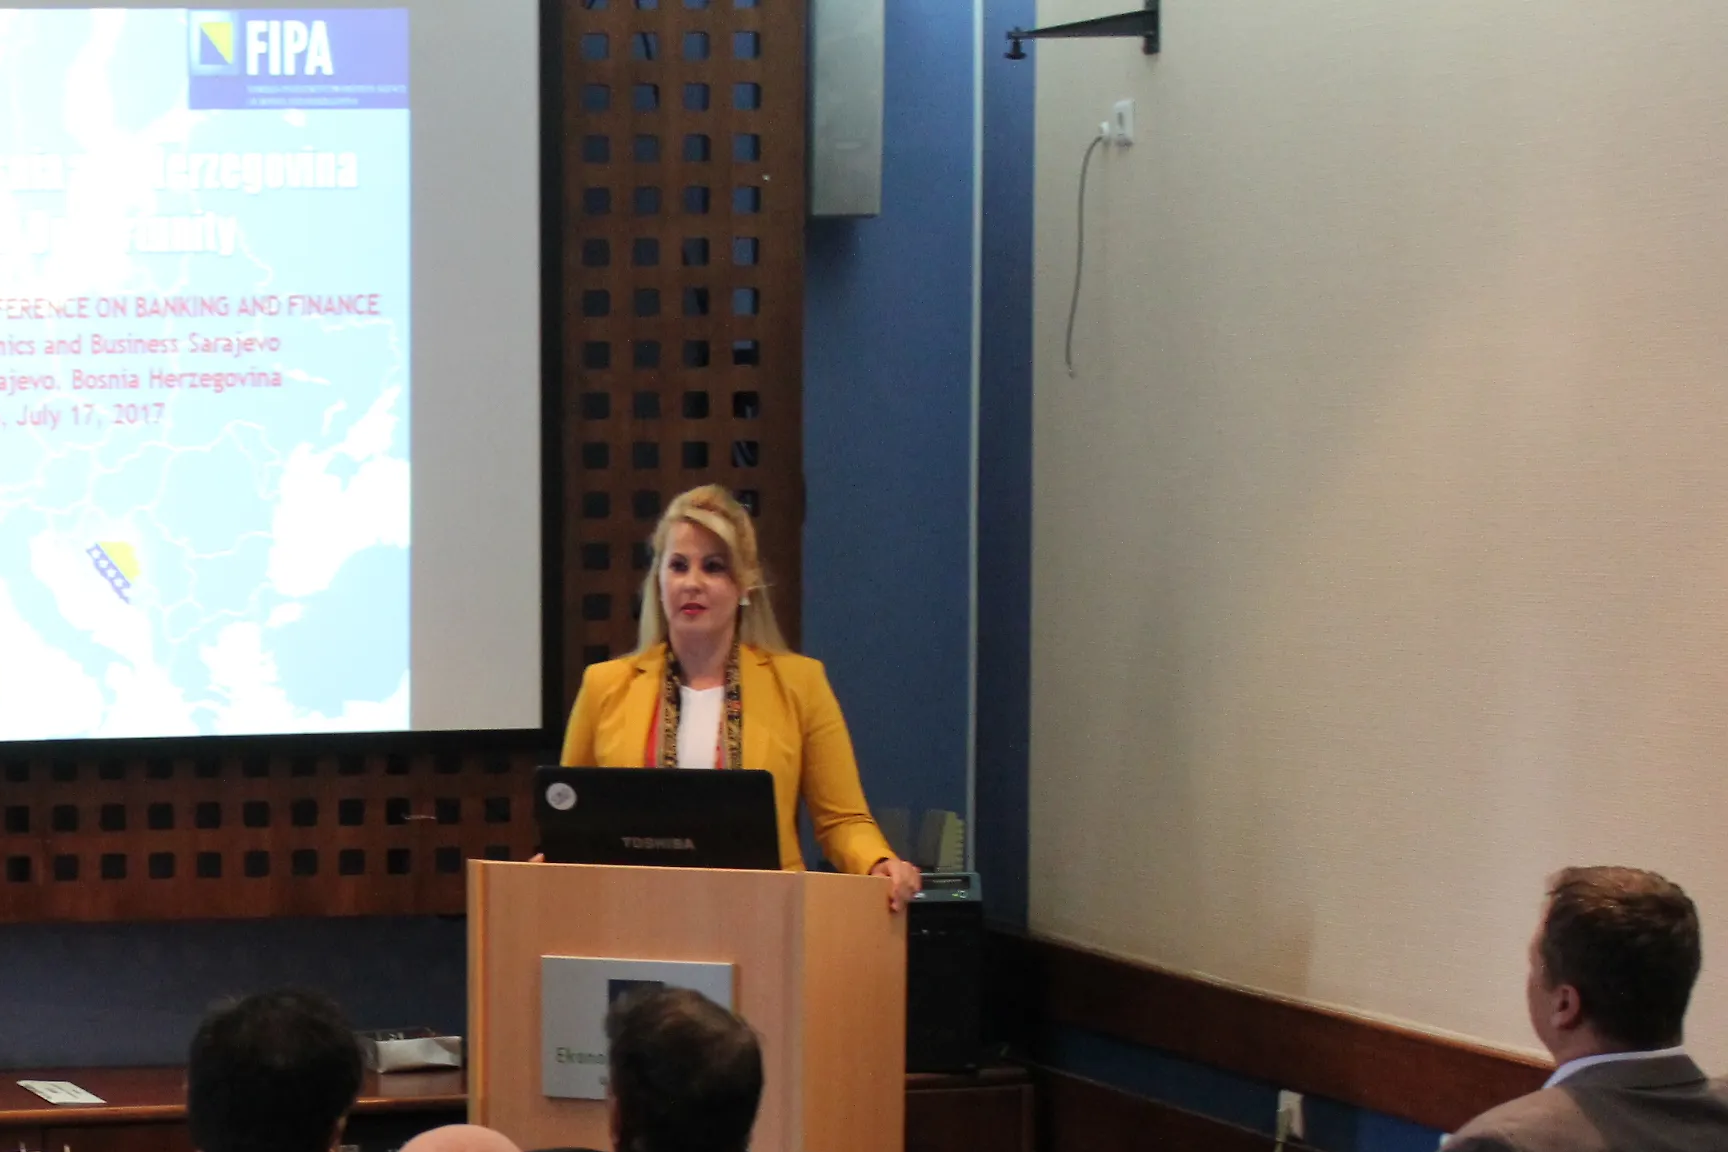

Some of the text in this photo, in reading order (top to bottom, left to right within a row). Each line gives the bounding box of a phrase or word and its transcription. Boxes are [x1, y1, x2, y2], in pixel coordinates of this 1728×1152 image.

[246, 19, 334, 76] FIPA
[96, 297, 127, 319] ON
[135, 295, 229, 318] BANKING
[237, 295, 281, 317] AND
[287, 293, 382, 316] FINANCE
[44, 335, 82, 355] and
[91, 333, 179, 355] Business
[188, 332, 282, 357] Sarajevo
[71, 368, 139, 391] Bosnia
[149, 366, 283, 393] Herzegovina
[16, 403, 61, 430] July
[114, 402, 165, 425] 2017
[619, 836, 696, 850] TOSHIBA
